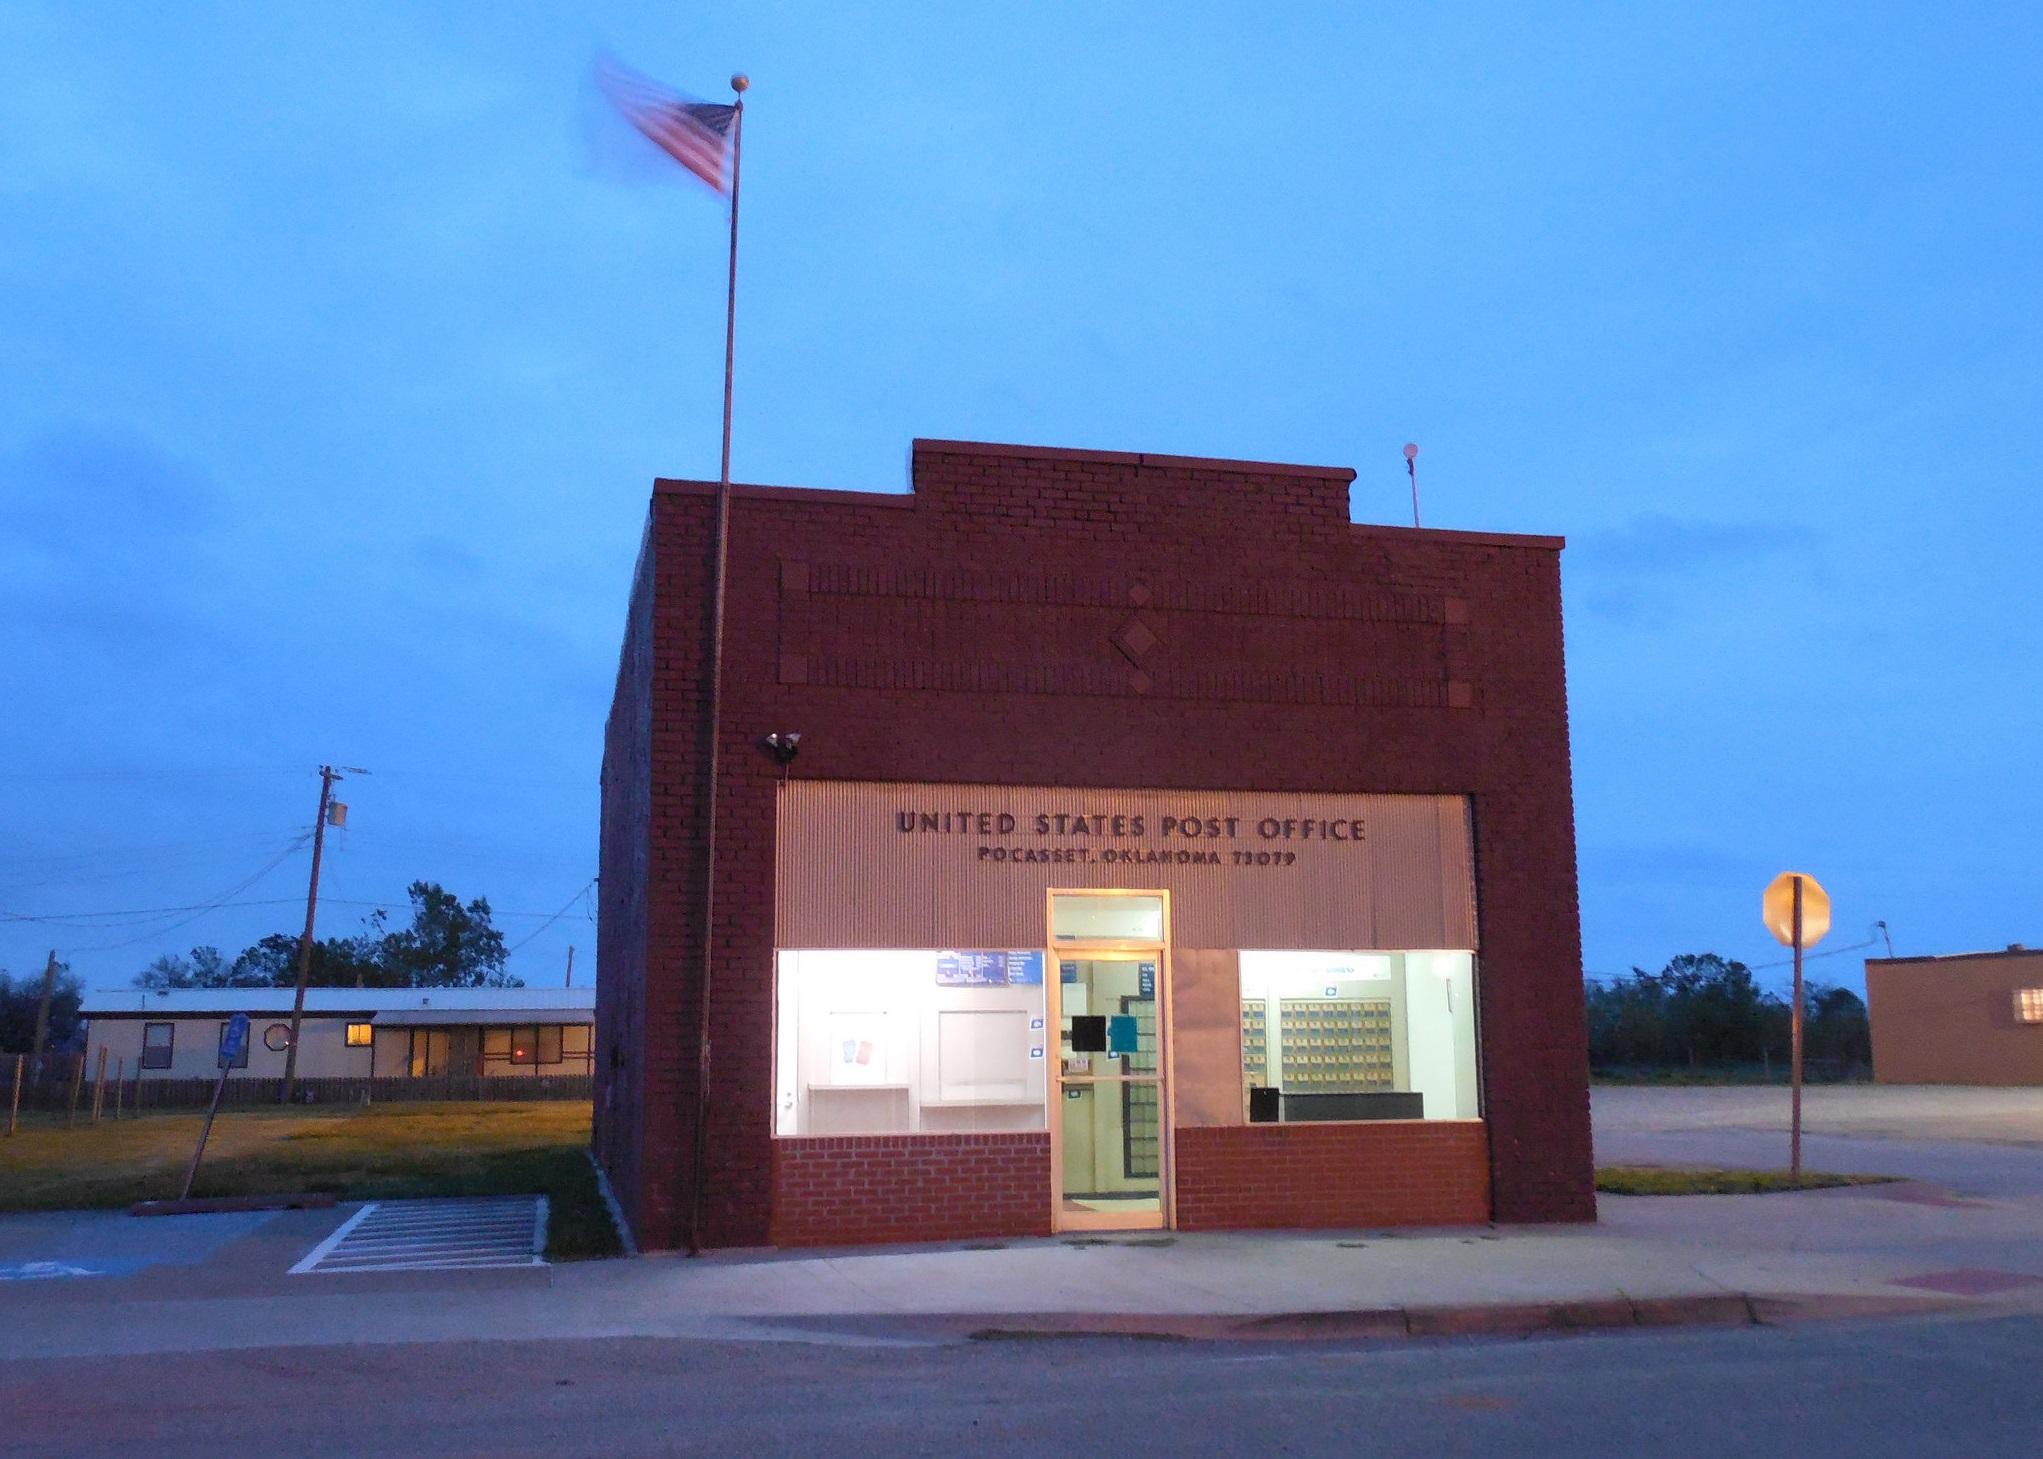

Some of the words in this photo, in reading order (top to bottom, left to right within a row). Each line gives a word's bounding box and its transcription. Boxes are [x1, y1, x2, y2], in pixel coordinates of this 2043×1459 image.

[896, 811, 1016, 834] UNITED
[1036, 813, 1145, 838] STATES
[1161, 815, 1239, 839] POST
[1257, 817, 1366, 841] OFFICE
[1103, 848, 1221, 866] OKLAHOMA
[1233, 850, 1296, 867] 73079
